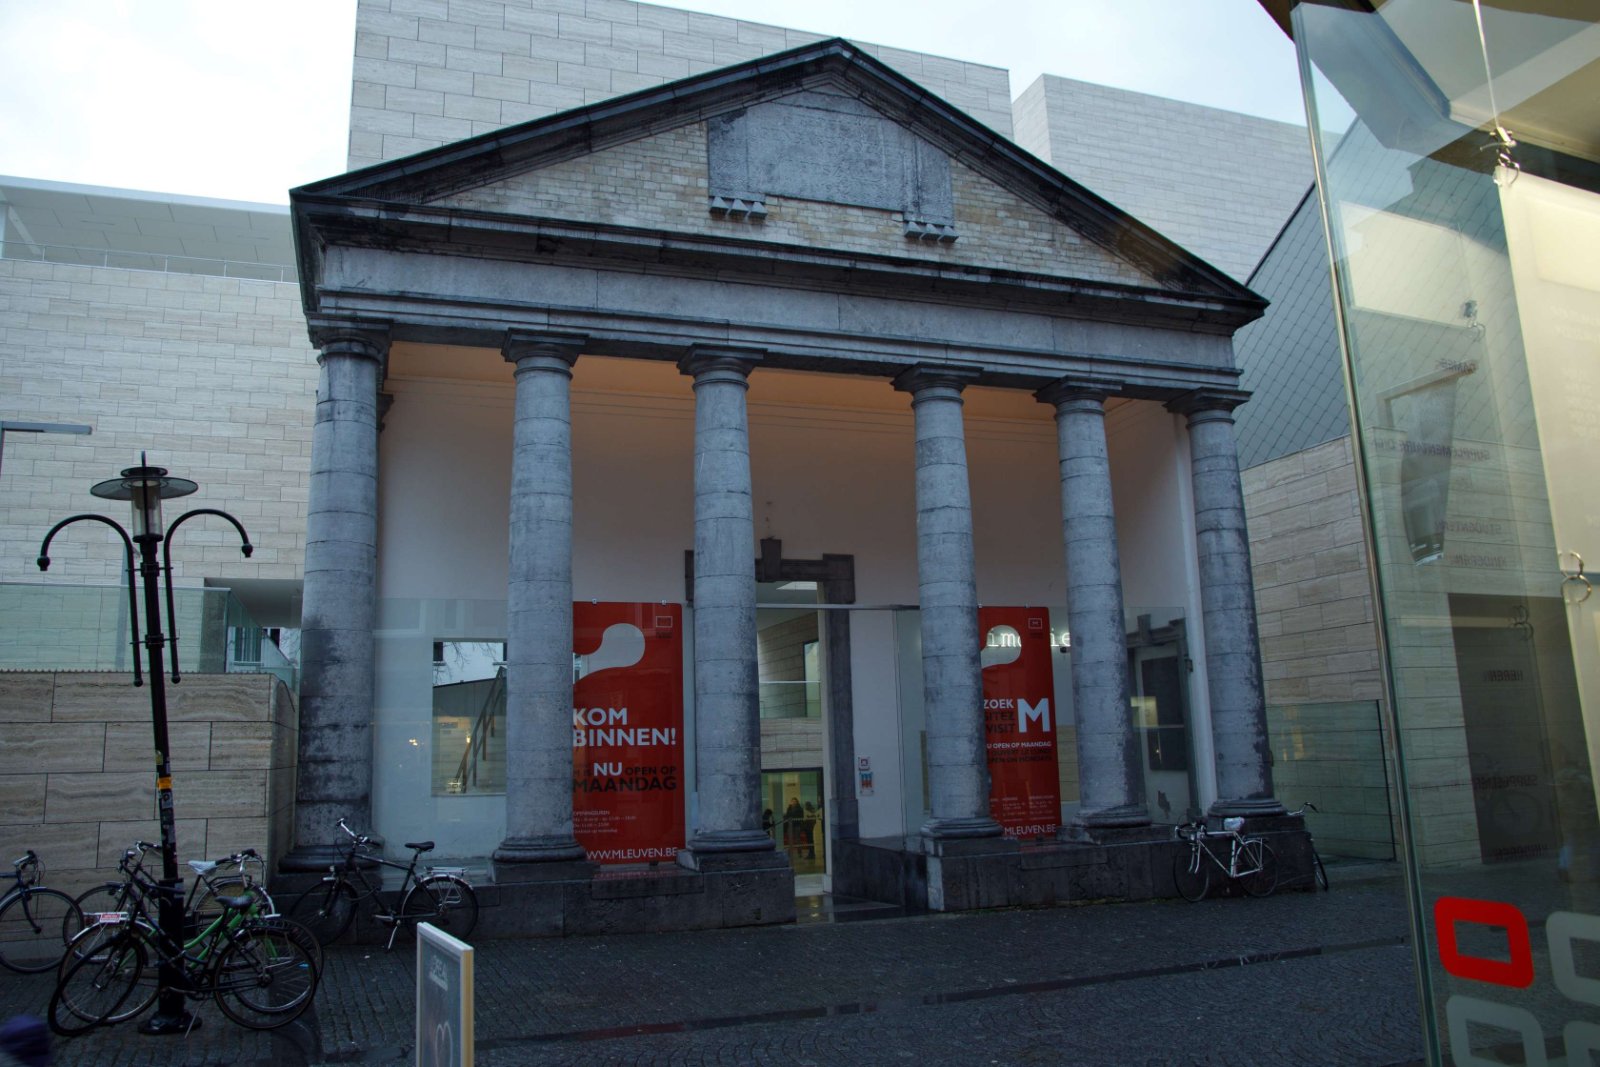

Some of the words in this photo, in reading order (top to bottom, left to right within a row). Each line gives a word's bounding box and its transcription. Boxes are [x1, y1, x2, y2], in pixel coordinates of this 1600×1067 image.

[573, 707, 628, 726] KOM
[1017, 697, 1051, 733] M
[573, 727, 677, 747] BINNEN!
[593, 762, 622, 777] NU
[625, 766, 656, 776] OPEN
[660, 765, 676, 775] OP
[573, 775, 677, 793] MAANDAG
